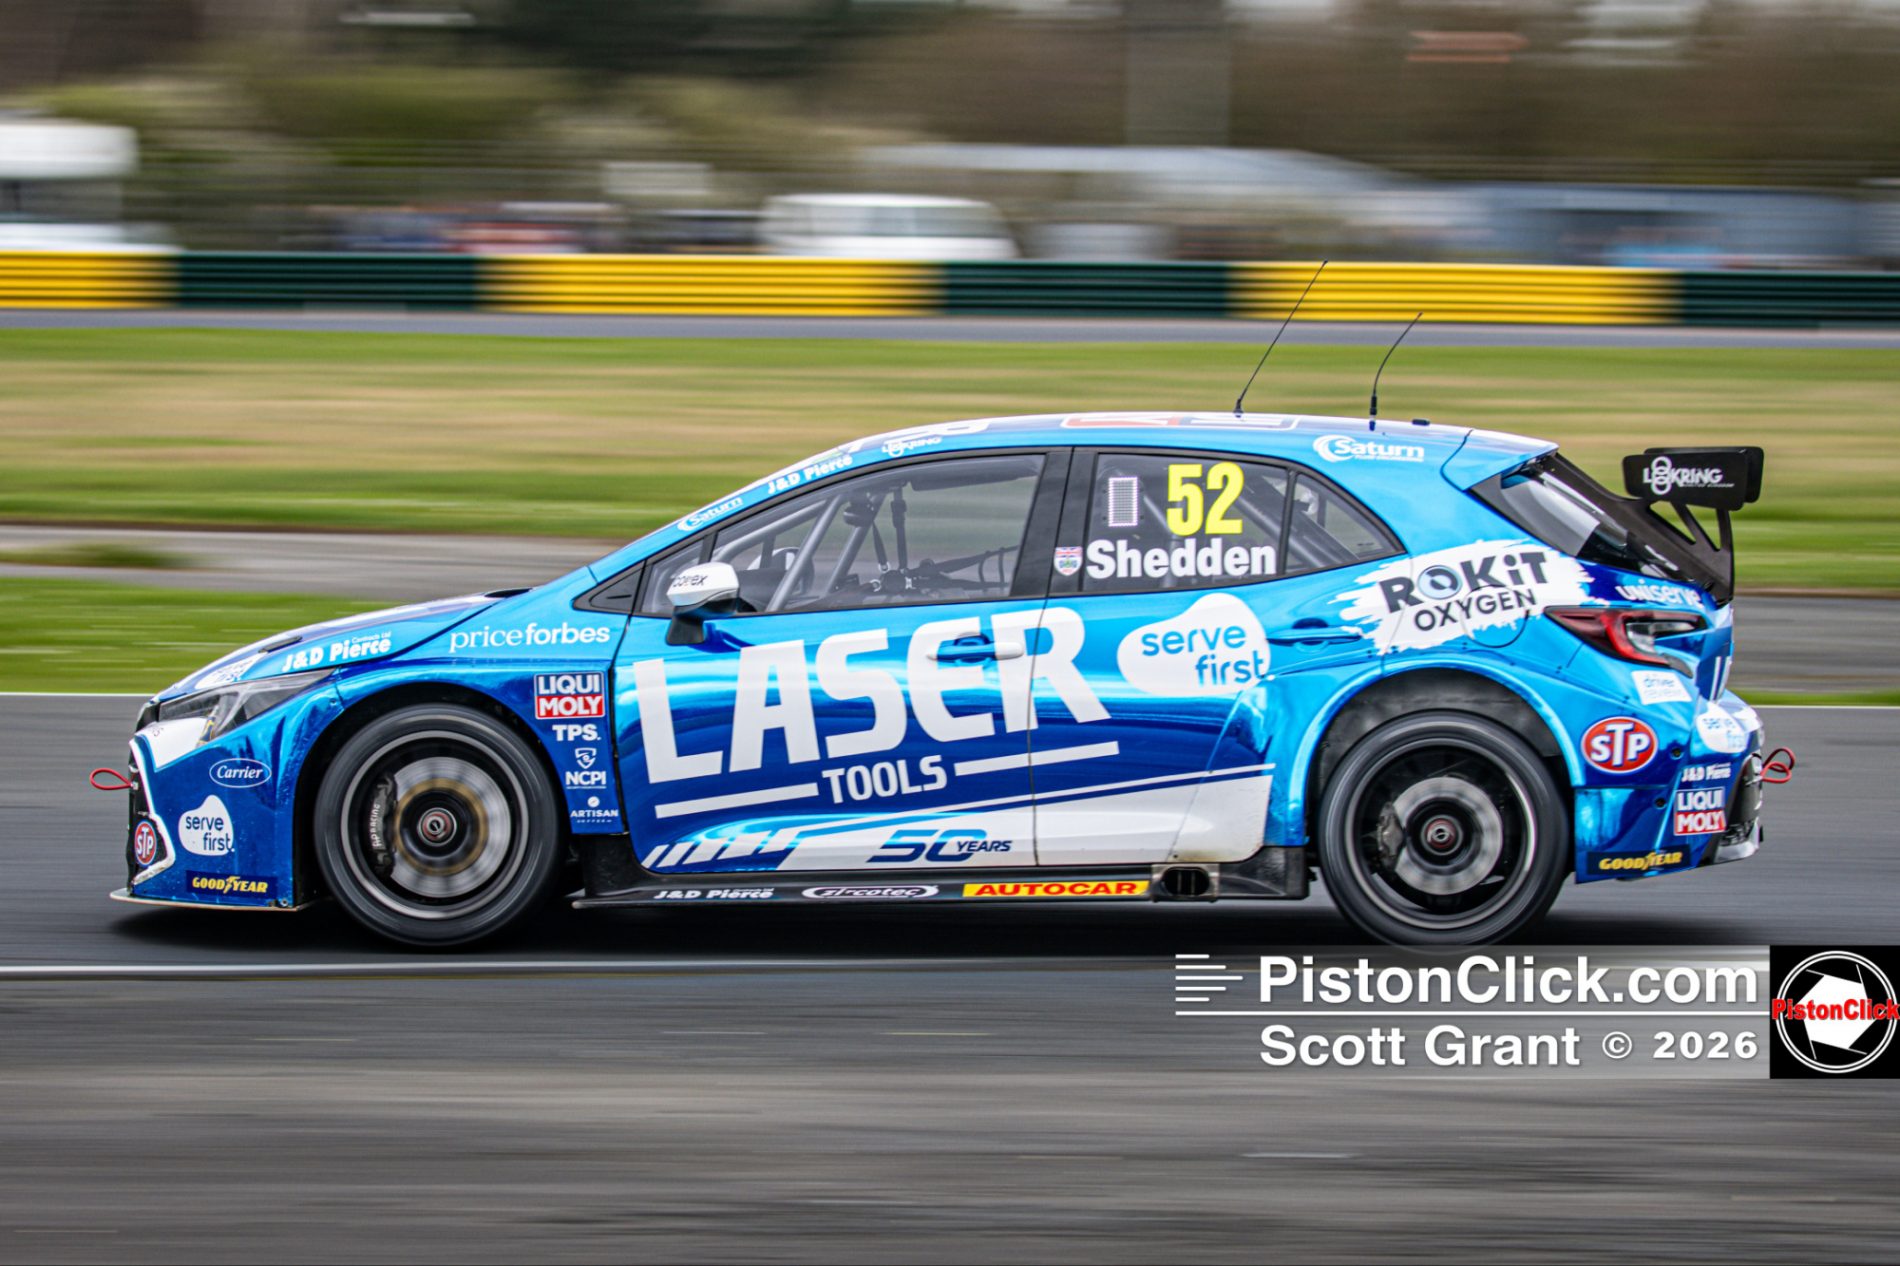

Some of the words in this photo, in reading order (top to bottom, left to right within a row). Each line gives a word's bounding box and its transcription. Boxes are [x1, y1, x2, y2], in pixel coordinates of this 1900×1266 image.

[1332, 438, 1425, 458] Saturn
[768, 472, 800, 495] J&D
[804, 455, 853, 481] Pierce
[688, 497, 743, 523] Saturn
[1166, 461, 1245, 536] 52
[1085, 537, 1277, 579] Shedden
[1614, 578, 1705, 609] uniserve
[1414, 588, 1537, 632] OXYGEN
[449, 625, 523, 653] price
[525, 622, 611, 646] forbes
[1141, 625, 1247, 657] serve
[281, 646, 324, 673] J&D
[329, 638, 392, 662] Pierce
[537, 674, 600, 696] LIQUI
[634, 605, 1112, 784] LASER
[538, 695, 603, 716] MOLY
[1590, 722, 1650, 767] STP
[216, 765, 264, 779] Carrier
[565, 770, 607, 786] NCPI
[822, 754, 948, 804] TOOLS
[1676, 788, 1724, 811] LIQUI
[185, 815, 224, 831] serve
[570, 809, 619, 818] ARTISAN
[1676, 811, 1725, 833] MOLY
[136, 826, 154, 860] STP
[865, 829, 987, 863] 50
[956, 840, 1013, 852] YEARS
[1599, 851, 1683, 870] GOODYEAR
[192, 875, 269, 894] GOODYEAR
[653, 889, 702, 899] J&D
[706, 888, 774, 899] Pierce
[820, 887, 921, 896] zircotec
[975, 882, 1138, 897] AUTOCAR
